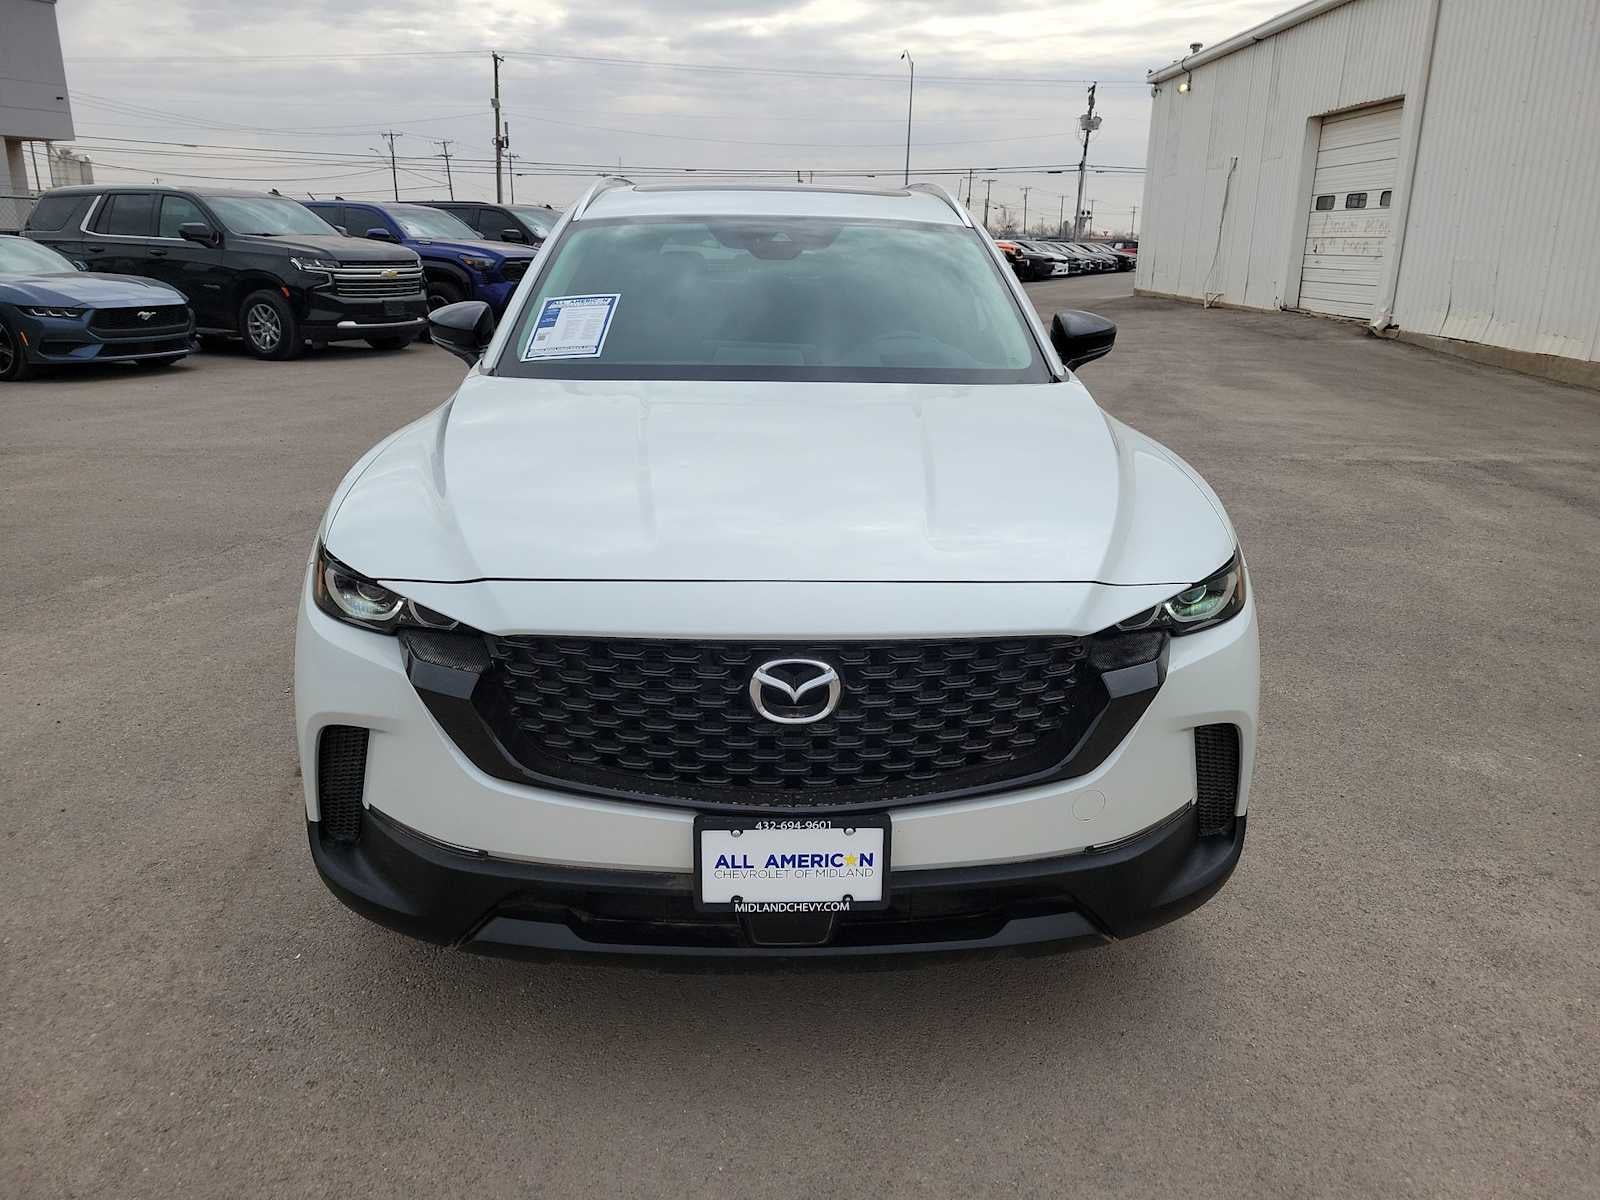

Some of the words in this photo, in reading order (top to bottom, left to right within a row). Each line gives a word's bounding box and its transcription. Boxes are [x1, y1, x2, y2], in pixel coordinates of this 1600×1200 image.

[755, 820, 832, 830] 432-694-9601
[714, 854, 754, 869] ALL
[764, 852, 874, 868] AMERICN
[714, 869, 790, 879] CHEVROLET
[794, 869, 812, 878] OF
[815, 868, 874, 878] MIDLAND
[734, 901, 850, 913] MIDLANDCHEVY.COM
